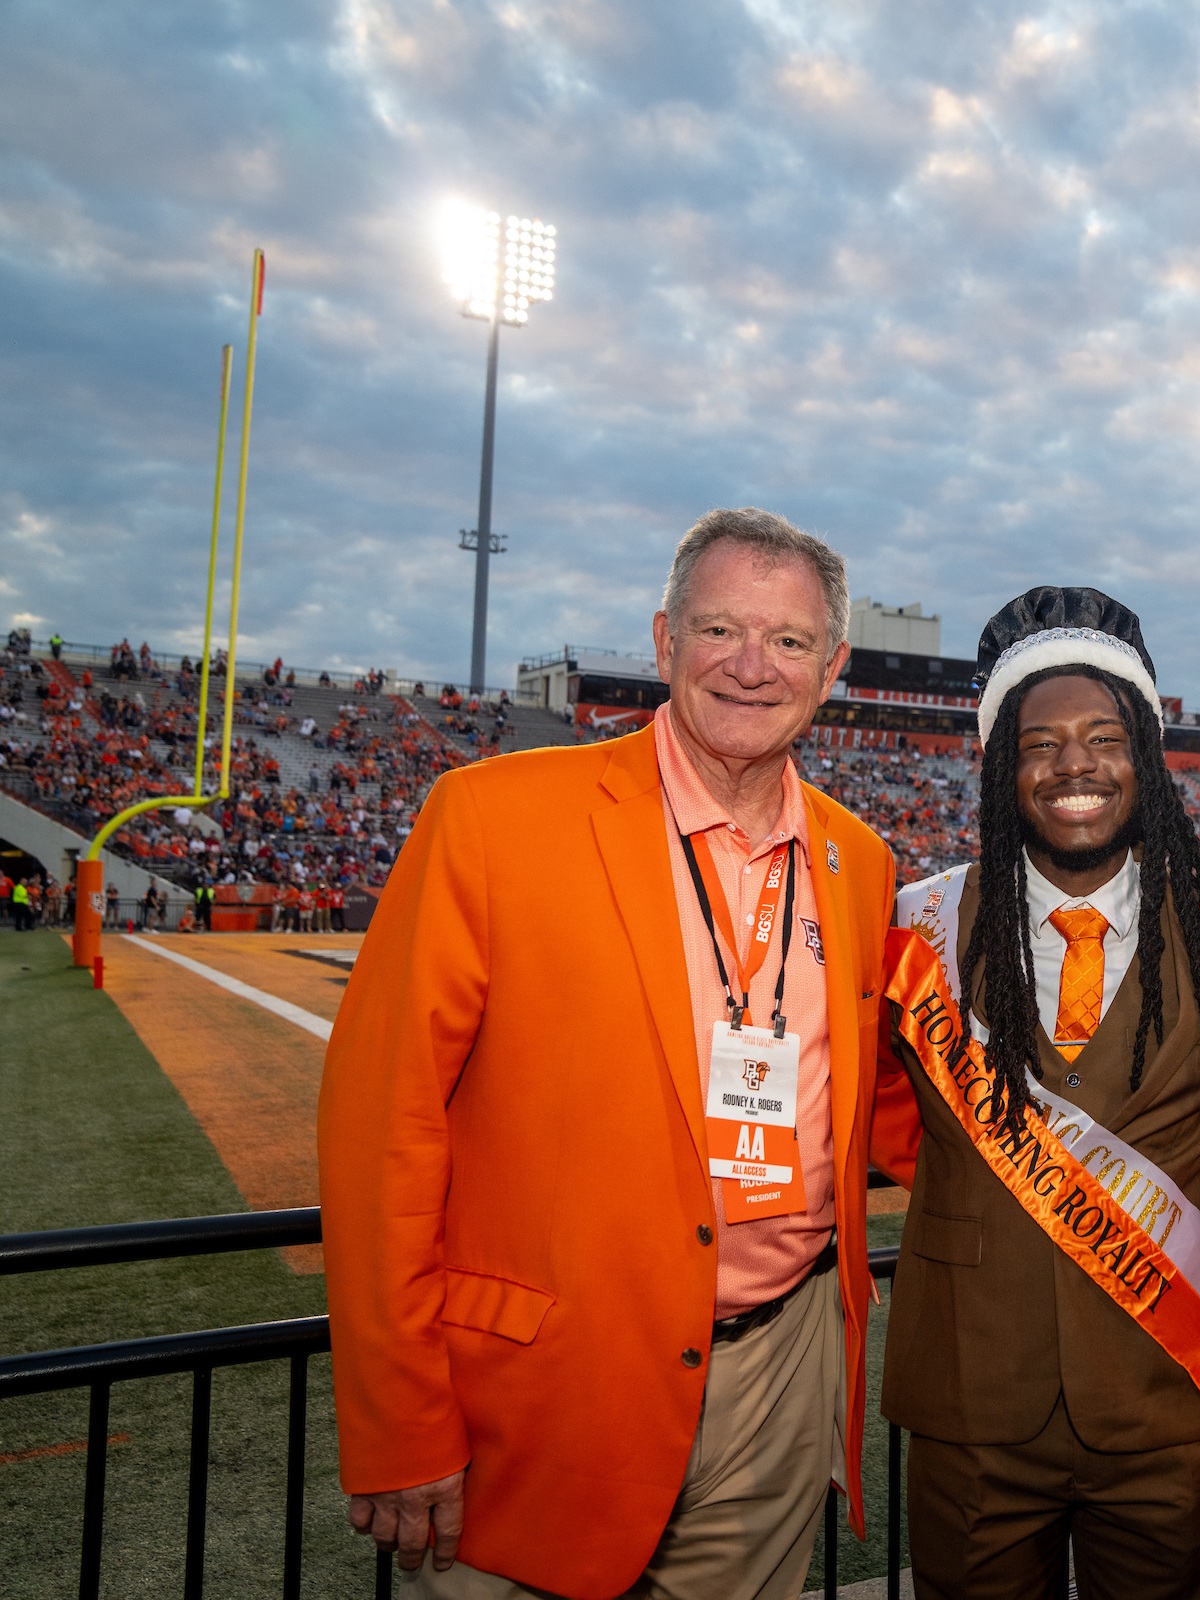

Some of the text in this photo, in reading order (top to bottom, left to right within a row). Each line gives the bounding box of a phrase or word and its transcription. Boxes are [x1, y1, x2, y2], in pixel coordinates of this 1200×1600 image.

[877, 689, 944, 706] WELCOME
[766, 854, 785, 888] BGSU
[756, 903, 775, 943] BGSU
[722, 1093, 783, 1113] RODNEY K. ROGERS
[735, 1124, 765, 1161] AA
[732, 1164, 767, 1177] ALL ACCESS
[746, 1191, 781, 1203] PRESIDENT
[1053, 1185, 1172, 1314] ROYALTY
